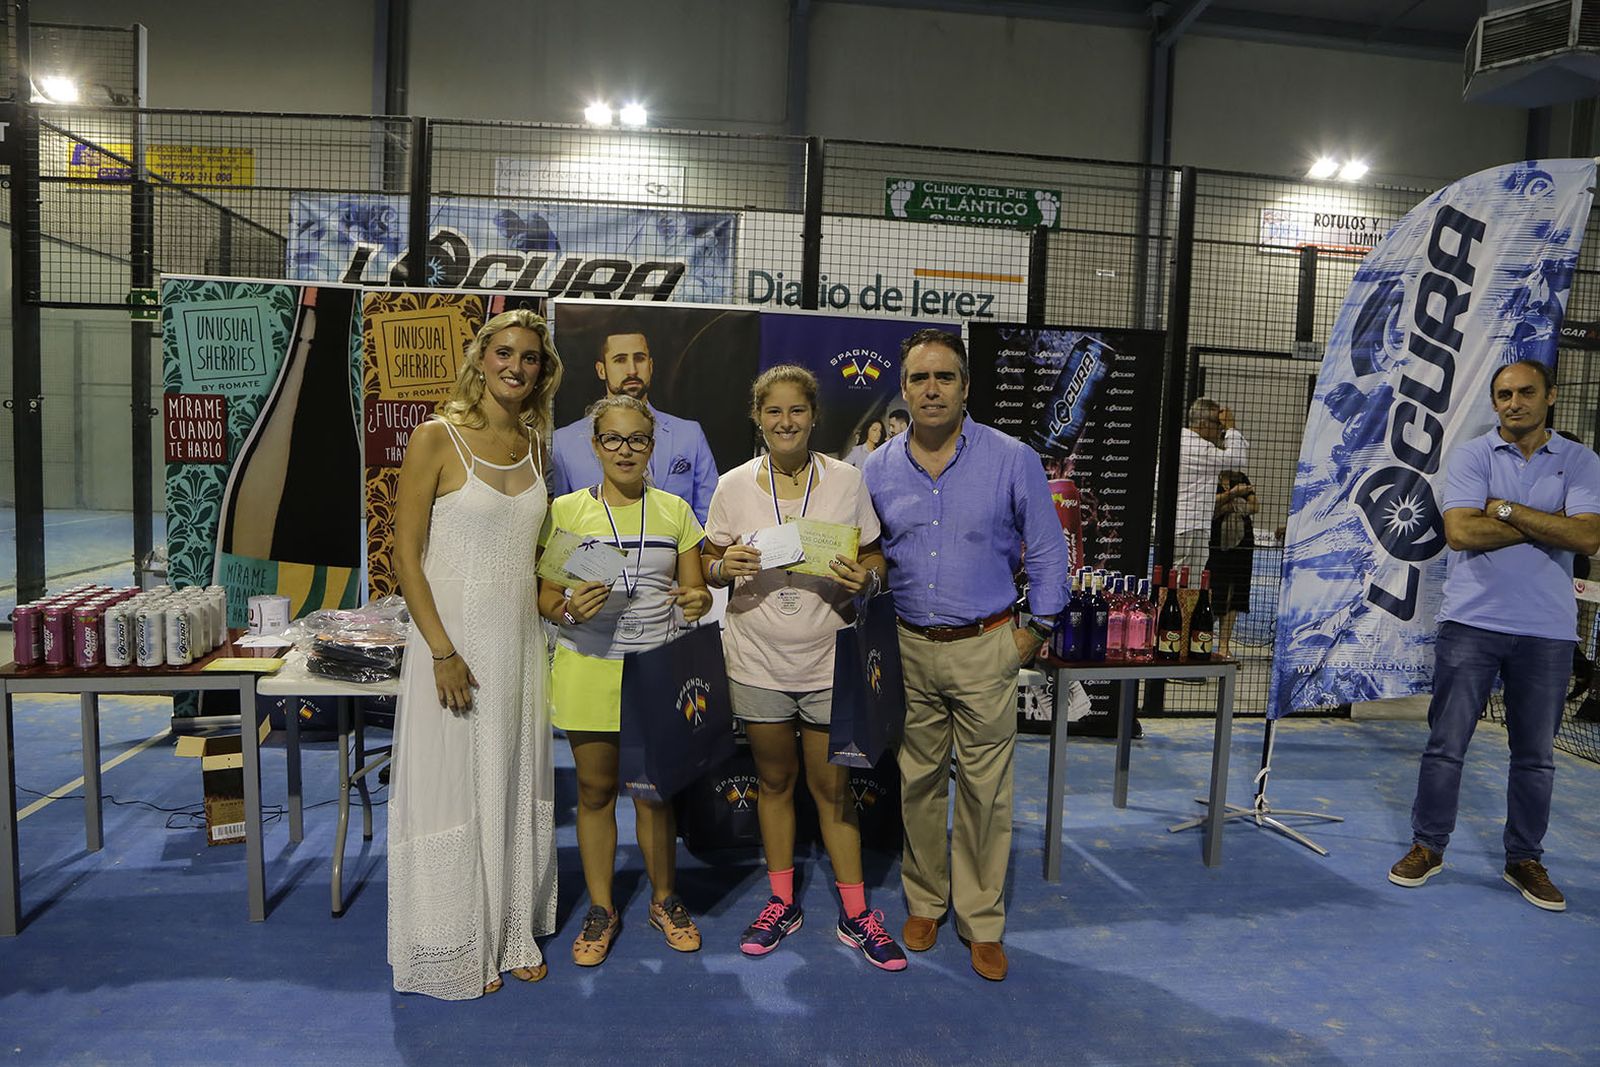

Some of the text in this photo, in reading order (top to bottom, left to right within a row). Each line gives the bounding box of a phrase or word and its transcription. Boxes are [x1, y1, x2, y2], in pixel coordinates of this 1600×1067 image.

[979, 187, 1003, 197] DEL
[1006, 188, 1027, 200] PIE
[921, 195, 1028, 216] ATLÁNTICO
[1314, 213, 1366, 231] ROTULOS
[1372, 217, 1380, 231] Y
[342, 230, 686, 301] LOCURA
[748, 270, 995, 318] Diaio de Jerez
[197, 315, 256, 342] UNUSUAL
[1560, 327, 1587, 338] GAR
[394, 325, 447, 351] UNUSUAL
[197, 345, 256, 372] SHERRIES
[830, 349, 892, 369] SPAGNOLO
[998, 349, 1026, 357] LOCURA
[394, 354, 448, 379] SHERRIES
[997, 366, 1025, 374] LOCURA
[1110, 371, 1136, 379] OCURA
[202, 380, 261, 392] BY ROMATE
[397, 387, 450, 399] BY ROMATE
[996, 383, 1025, 391] LOCURA
[1048, 351, 1096, 436] LOCURA
[1106, 387, 1134, 396] LOCURA
[168, 395, 222, 419] MÍRAME
[995, 400, 1023, 408] LOCURA
[1105, 404, 1133, 412] LOCURA
[1354, 204, 1487, 622] LOCURA
[367, 403, 427, 433] ¿FUEGO?
[1104, 421, 1132, 429] LOCURA
[169, 420, 223, 440] CUANDO
[396, 431, 409, 447] NO
[169, 441, 222, 458] TE HABLO
[1101, 454, 1129, 462] LOCURA
[226, 562, 267, 588] MÍRAME
[118, 624, 127, 660] LOCURA
[179, 622, 189, 659] LOCURA
[715, 776, 760, 793] SPAGNOL
